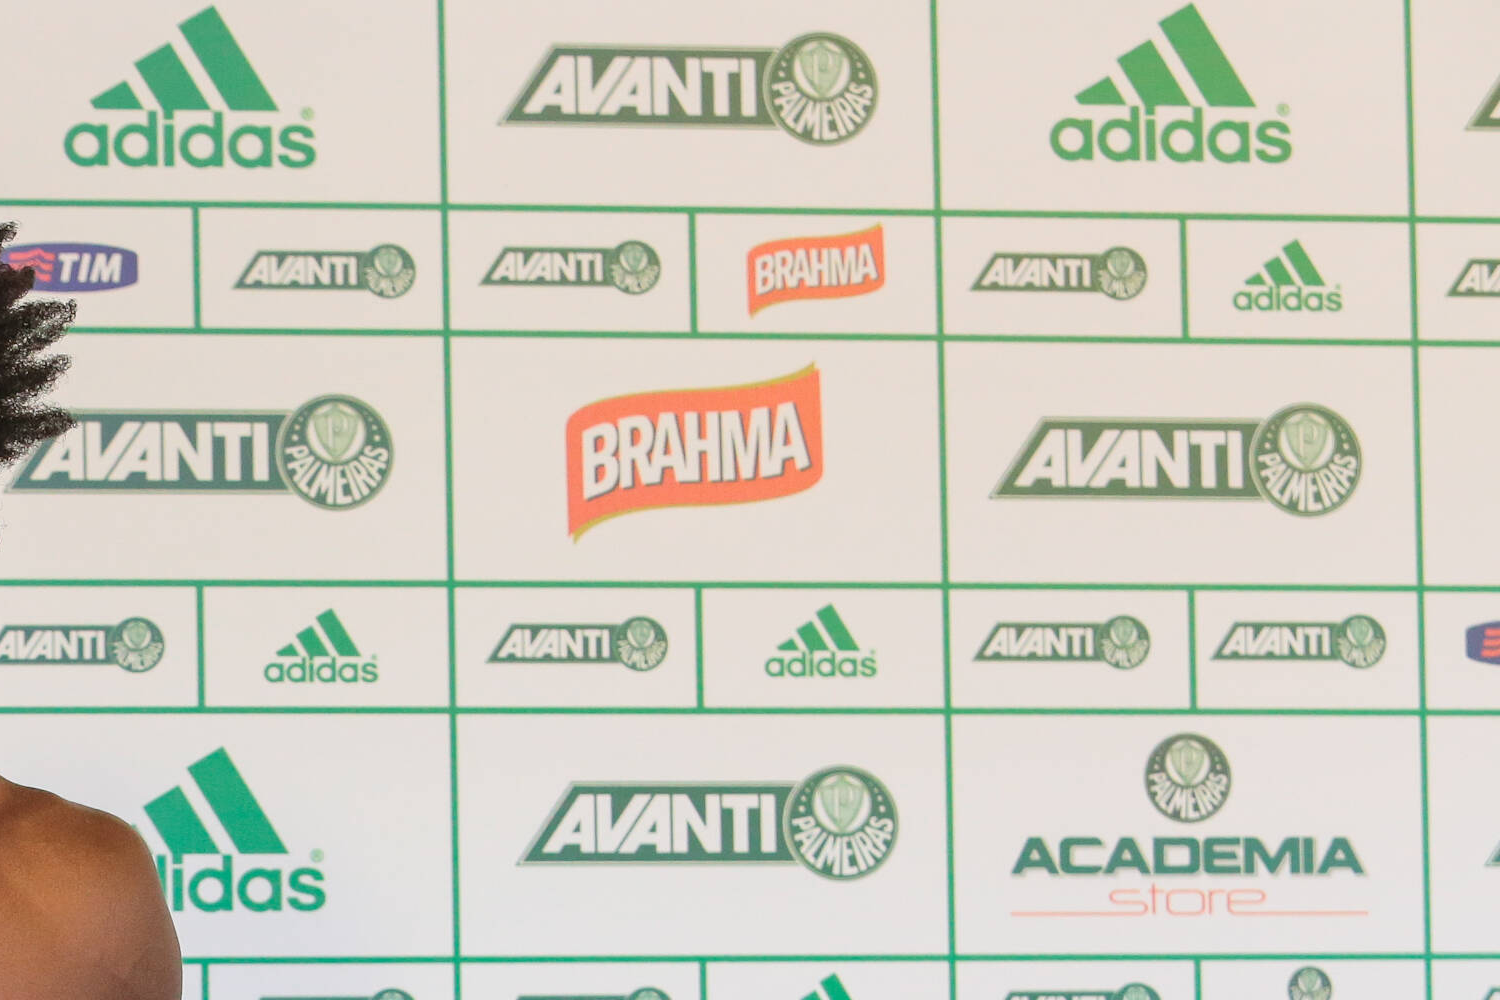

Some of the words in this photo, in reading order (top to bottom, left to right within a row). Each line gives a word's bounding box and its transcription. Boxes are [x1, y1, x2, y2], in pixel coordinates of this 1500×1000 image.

[530, 56, 755, 117] AVANTI
[772, 80, 872, 141] PALMEIRAS
[64, 111, 316, 168] adidas
[1049, 105, 1292, 164] adidas
[58, 252, 122, 283] TIM
[242, 255, 357, 287] AVANTI
[491, 251, 602, 281] AVANTI
[754, 243, 877, 296] BRAHMA
[979, 258, 1090, 287] AVANTI
[1232, 282, 1342, 312] adidas
[30, 421, 268, 481] AVANTI
[581, 402, 811, 501] BRAHMA
[1014, 429, 1242, 489] AVANTI
[284, 442, 389, 506] PALMEIRAS
[1258, 449, 1356, 512] PALMEIRAS
[497, 629, 611, 659] AVANTI
[765, 647, 877, 678] adidas
[983, 627, 1094, 657] AVANTI
[1221, 627, 1330, 656] AVANTI
[264, 652, 378, 683] adidas
[542, 794, 775, 853] AVANTI
[794, 815, 892, 877] PALMEIRAS
[1011, 837, 1365, 875] ACADEMIA
[1107, 883, 1267, 916] store
